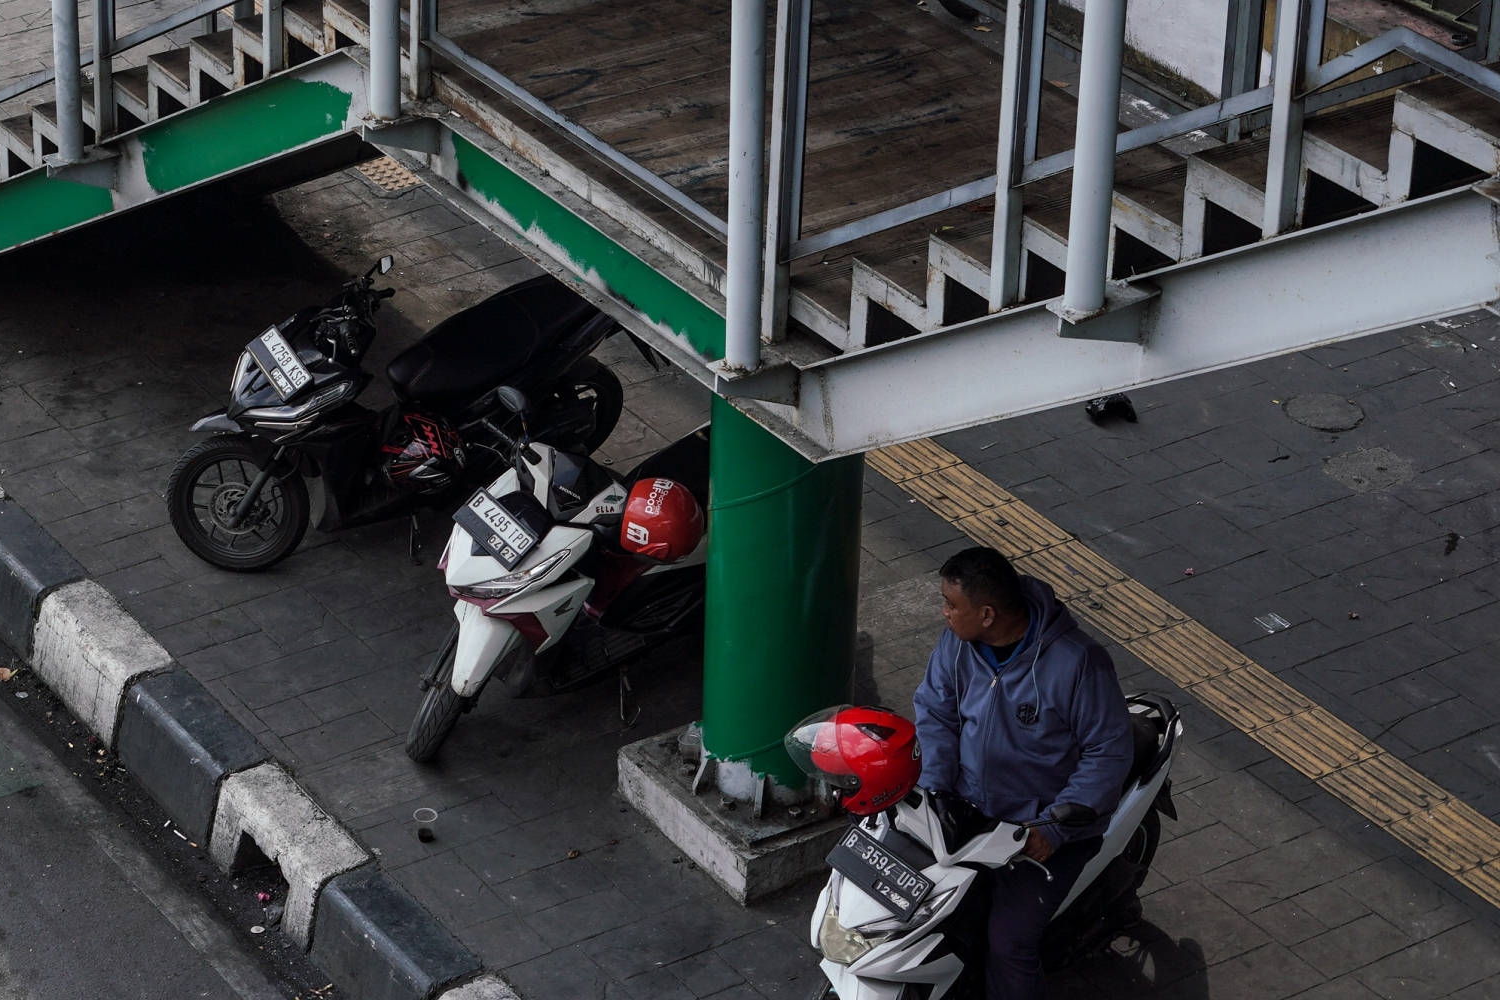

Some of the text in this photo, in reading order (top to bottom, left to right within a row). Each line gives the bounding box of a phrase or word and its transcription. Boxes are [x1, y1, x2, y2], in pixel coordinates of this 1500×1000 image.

[263, 332, 307, 386] B 4758 KSG
[559, 485, 581, 500] HONDA
[595, 505, 615, 514] ELLA
[472, 495, 530, 550] B 4495 TPD
[845, 834, 858, 848] B
[861, 845, 897, 876] 3594
